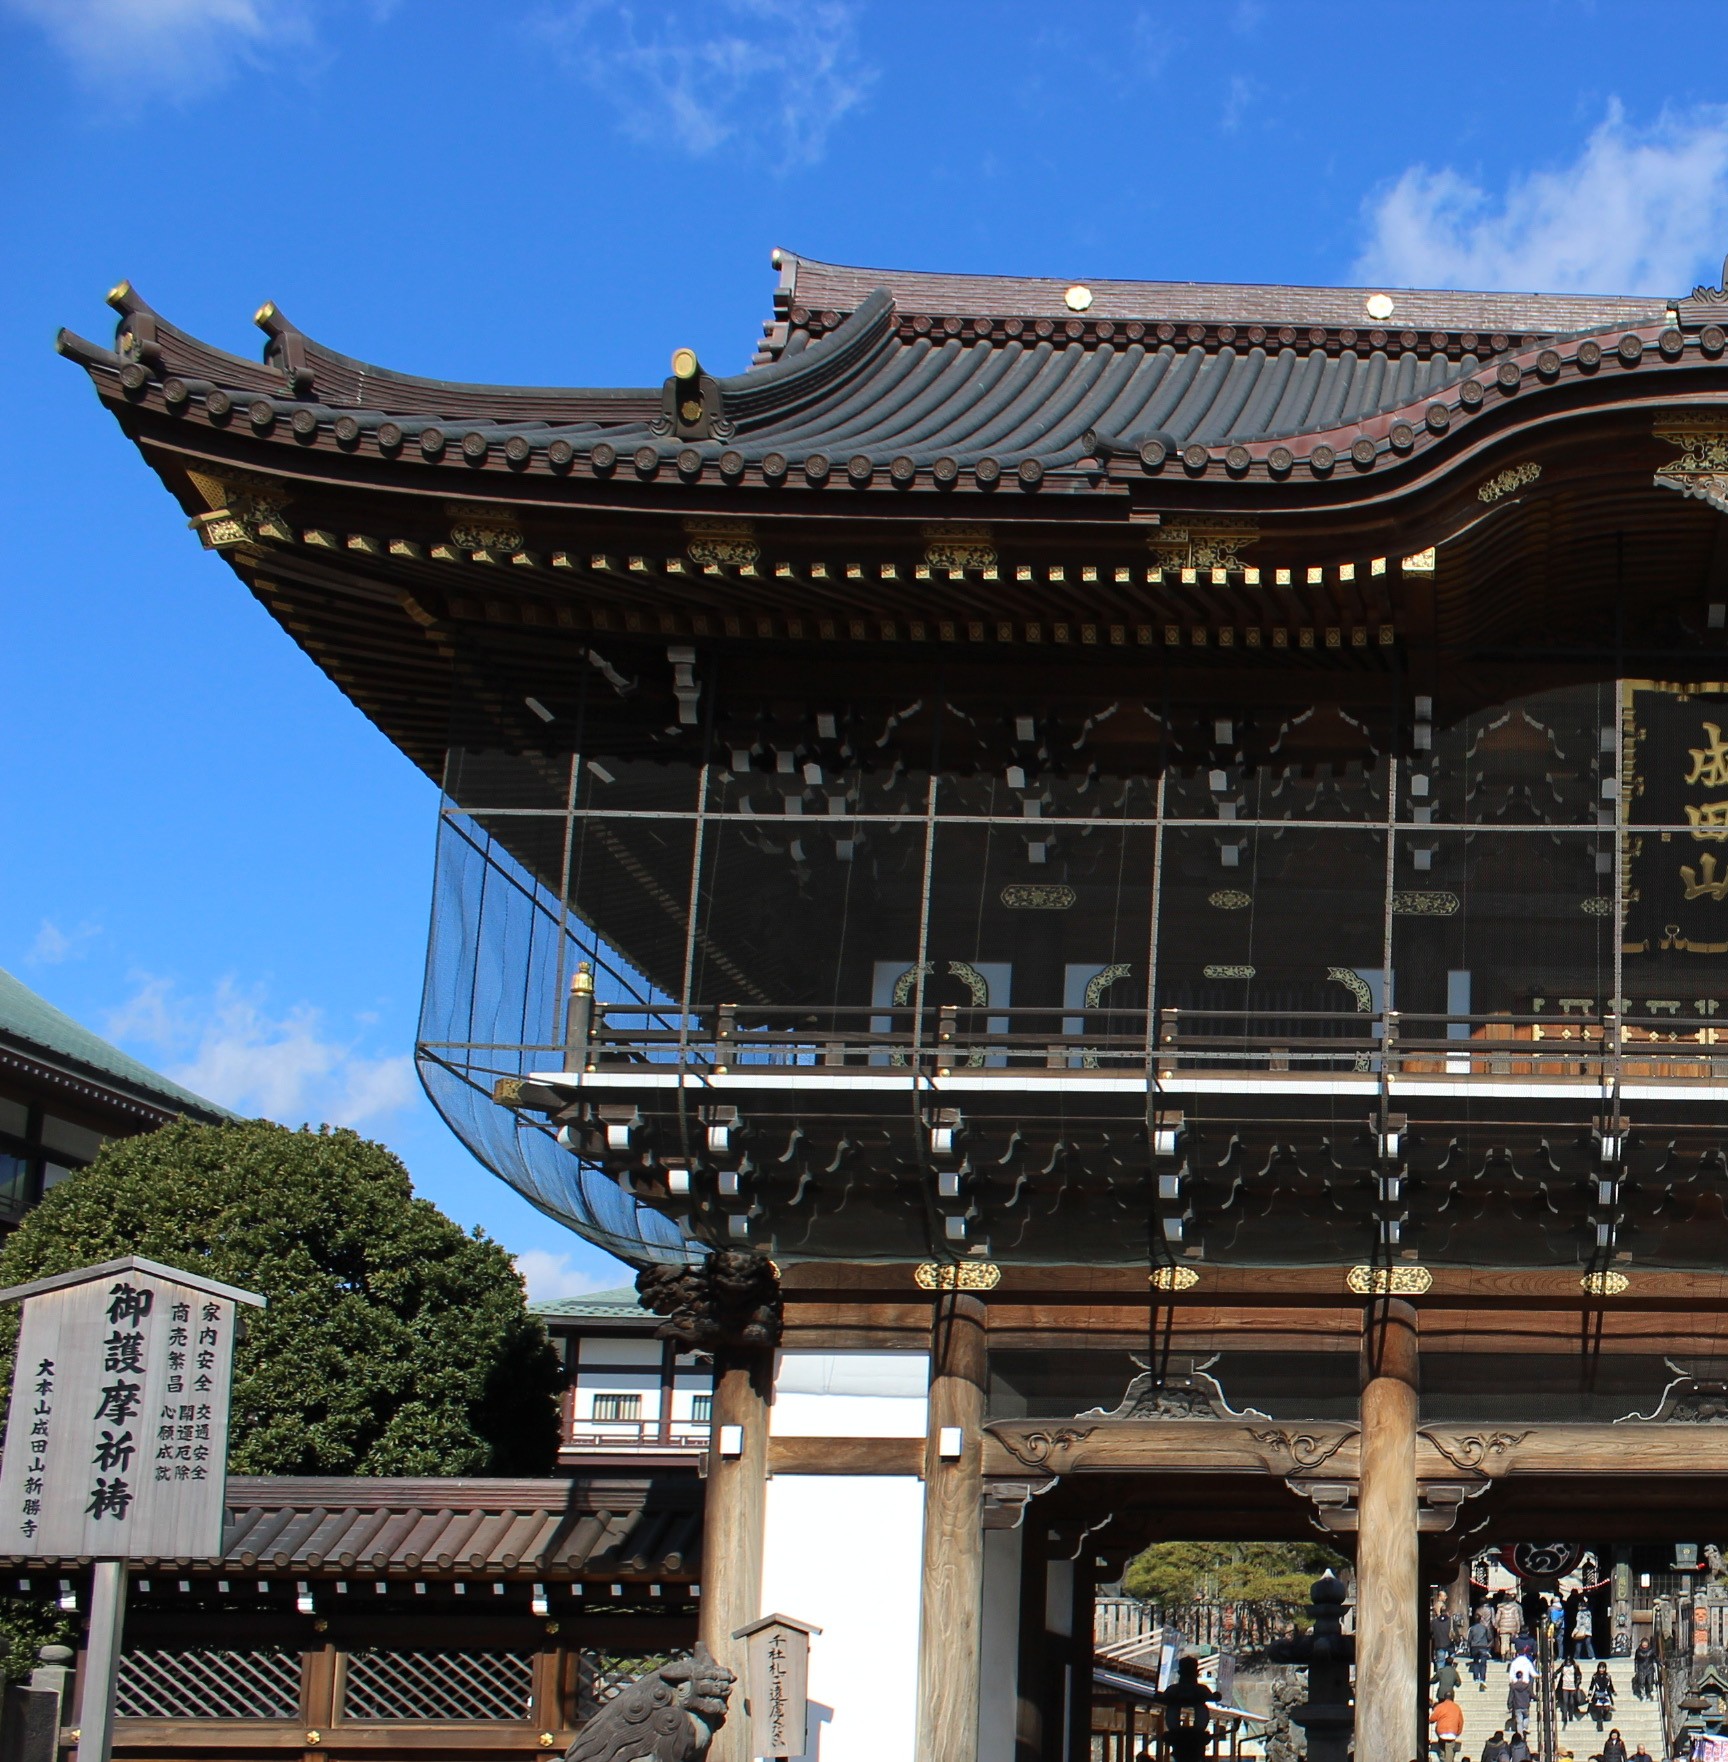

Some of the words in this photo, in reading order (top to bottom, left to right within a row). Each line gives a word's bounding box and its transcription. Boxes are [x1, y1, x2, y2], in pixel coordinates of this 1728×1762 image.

[167, 1302, 191, 1394] 商売繁昌
[191, 1301, 222, 1393] 家内安全
[20, 1358, 55, 1539] 大本山成田山新勝寺
[155, 1405, 177, 1481] 心願成就
[173, 1404, 195, 1481] 開運厄除
[191, 1404, 212, 1481] 交通安全
[768, 1634, 788, 1747] 千社札ご遠慮ください
